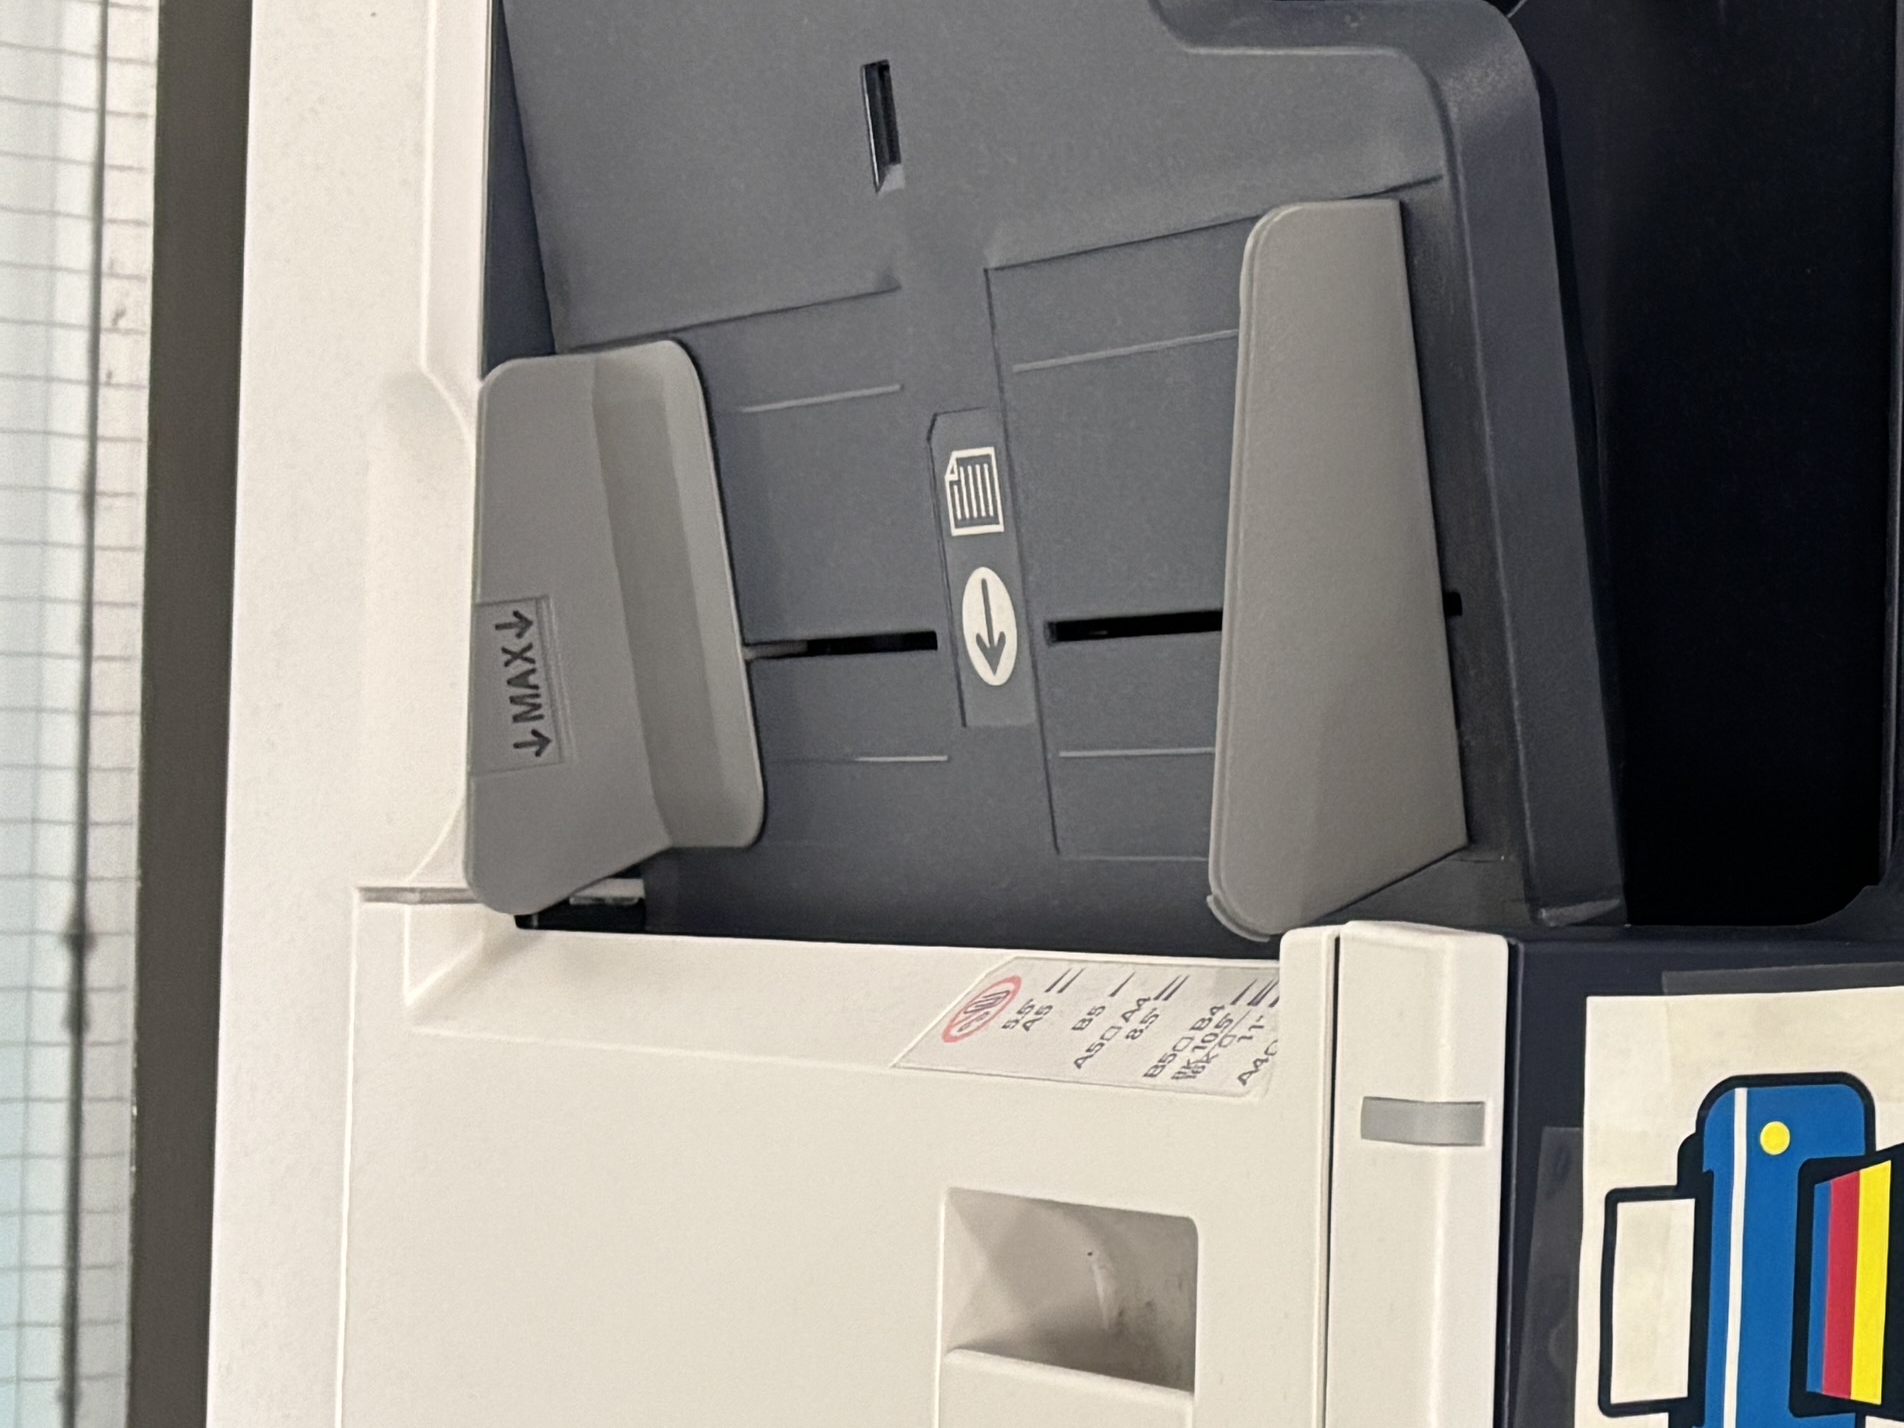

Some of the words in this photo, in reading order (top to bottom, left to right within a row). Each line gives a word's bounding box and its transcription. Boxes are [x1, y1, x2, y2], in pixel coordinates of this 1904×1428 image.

[501, 643, 544, 723] MAX
[1021, 1004, 1054, 1032] A5
[1071, 1005, 1106, 1031] B5
[1120, 995, 1152, 1023] A4
[1189, 1004, 1226, 1031] B4
